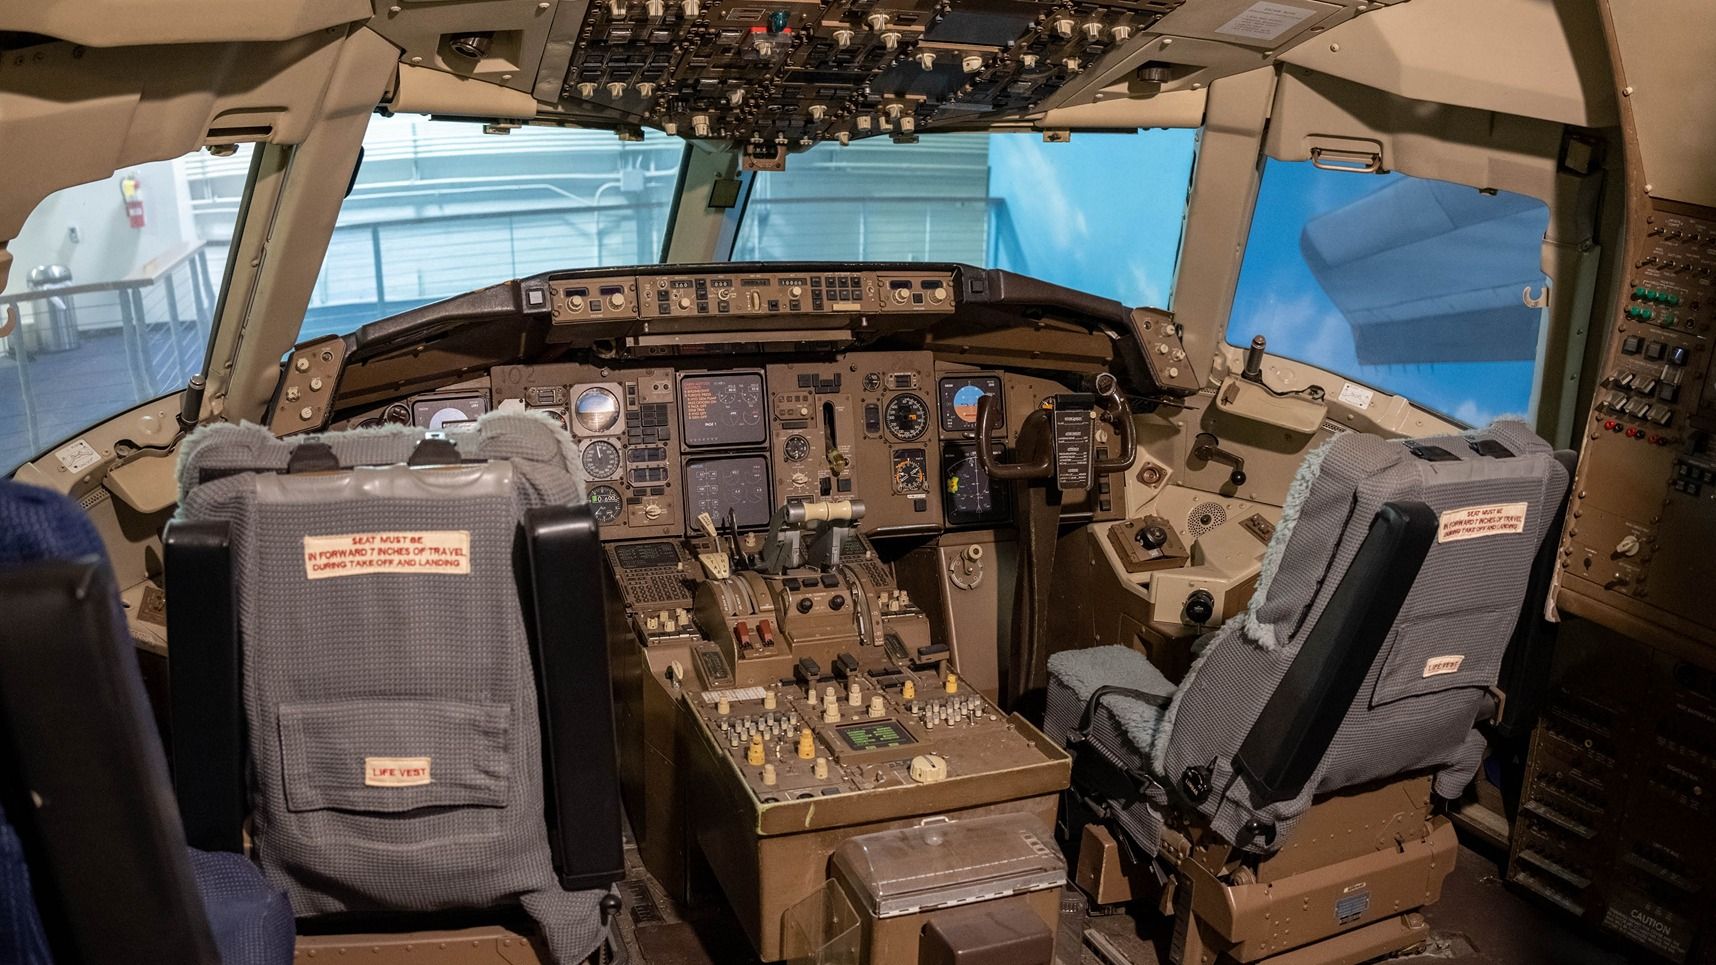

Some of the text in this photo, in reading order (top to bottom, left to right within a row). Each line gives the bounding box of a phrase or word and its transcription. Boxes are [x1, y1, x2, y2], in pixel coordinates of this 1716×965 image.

[1449, 520, 1474, 528] FORWARD
[1443, 530, 1461, 538] DURING
[1496, 524, 1518, 532] LANDING
[352, 536, 376, 545] SEAT
[380, 536, 408, 544] MUST
[308, 547, 466, 561] IN FORWARD 7 INCHES OF TRAVEL
[312, 561, 347, 572] DURING
[349, 560, 374, 568] TAKE
[376, 559, 394, 567] OFF
[418, 559, 460, 568] LANDING
[1428, 661, 1458, 672] LIFE VEST
[372, 768, 426, 777] LIFE VEST
[1631, 909, 1671, 935] CAUTION
